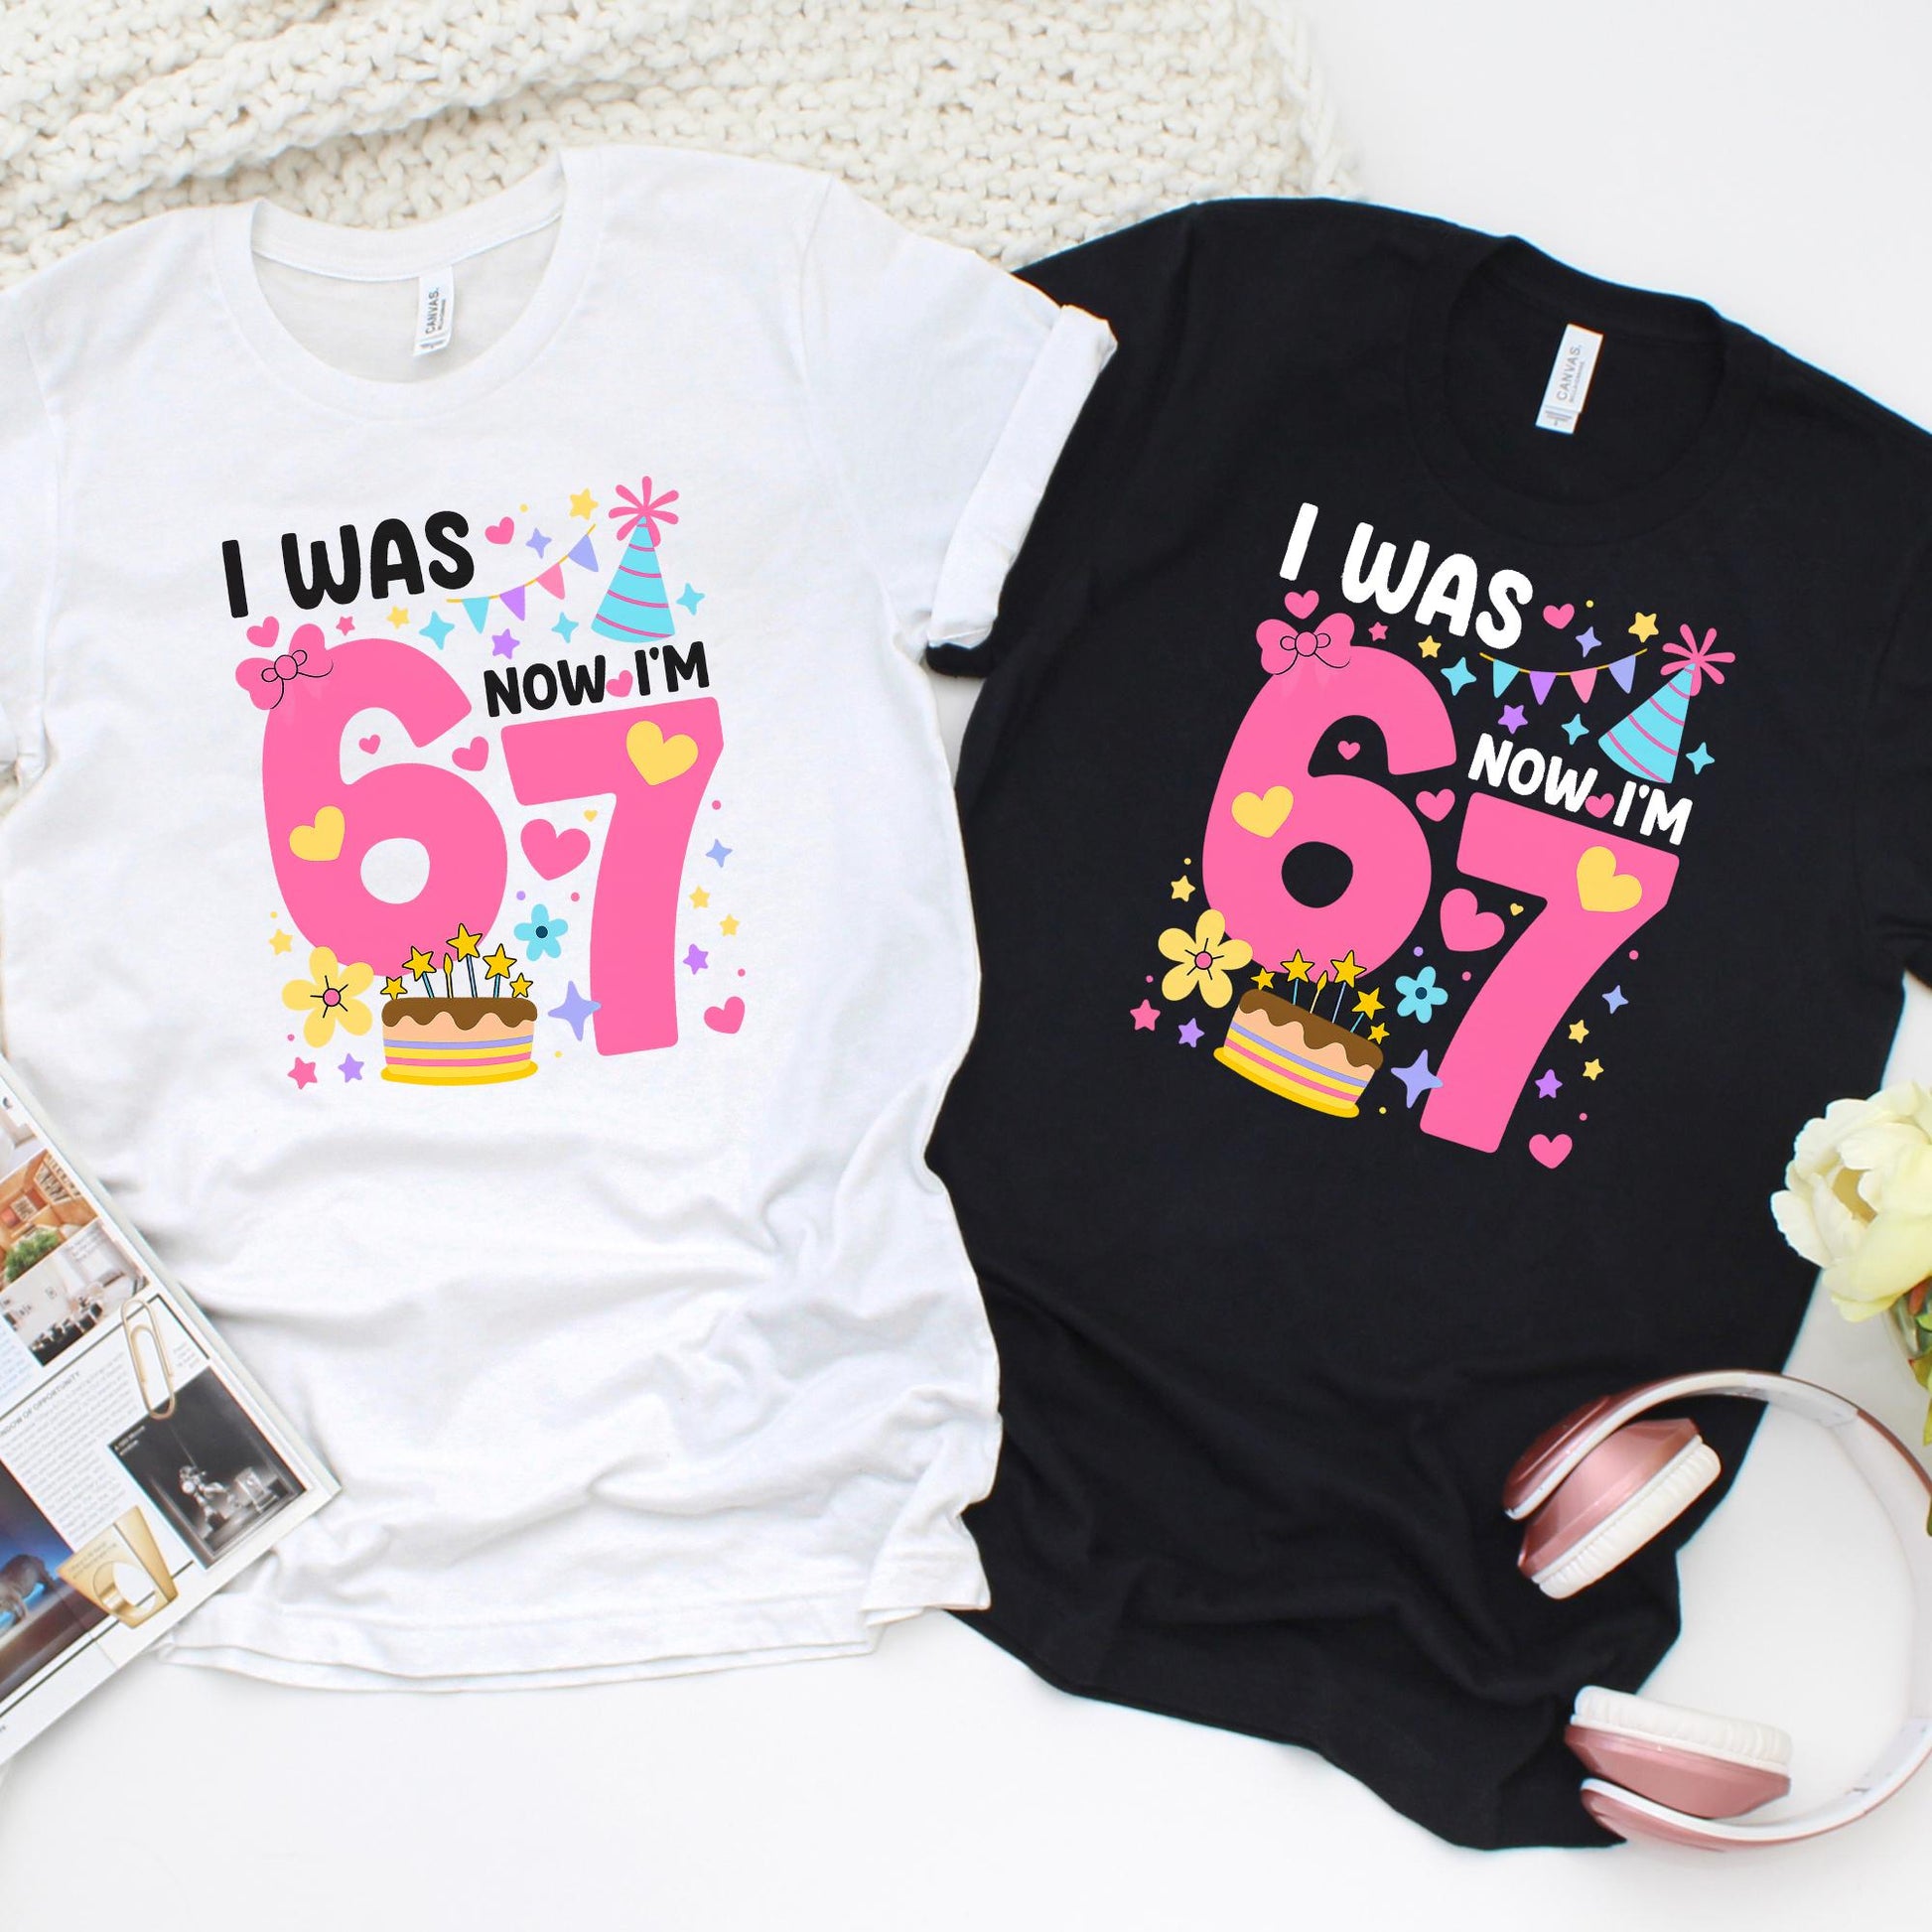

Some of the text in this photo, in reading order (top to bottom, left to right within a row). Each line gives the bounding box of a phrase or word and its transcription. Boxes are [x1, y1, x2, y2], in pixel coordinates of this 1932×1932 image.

[221, 510, 475, 619] I WAS
[1279, 502, 1533, 649] I WAS
[483, 640, 710, 718] NOW I'M
[1467, 733, 1693, 846] NOW I'M
